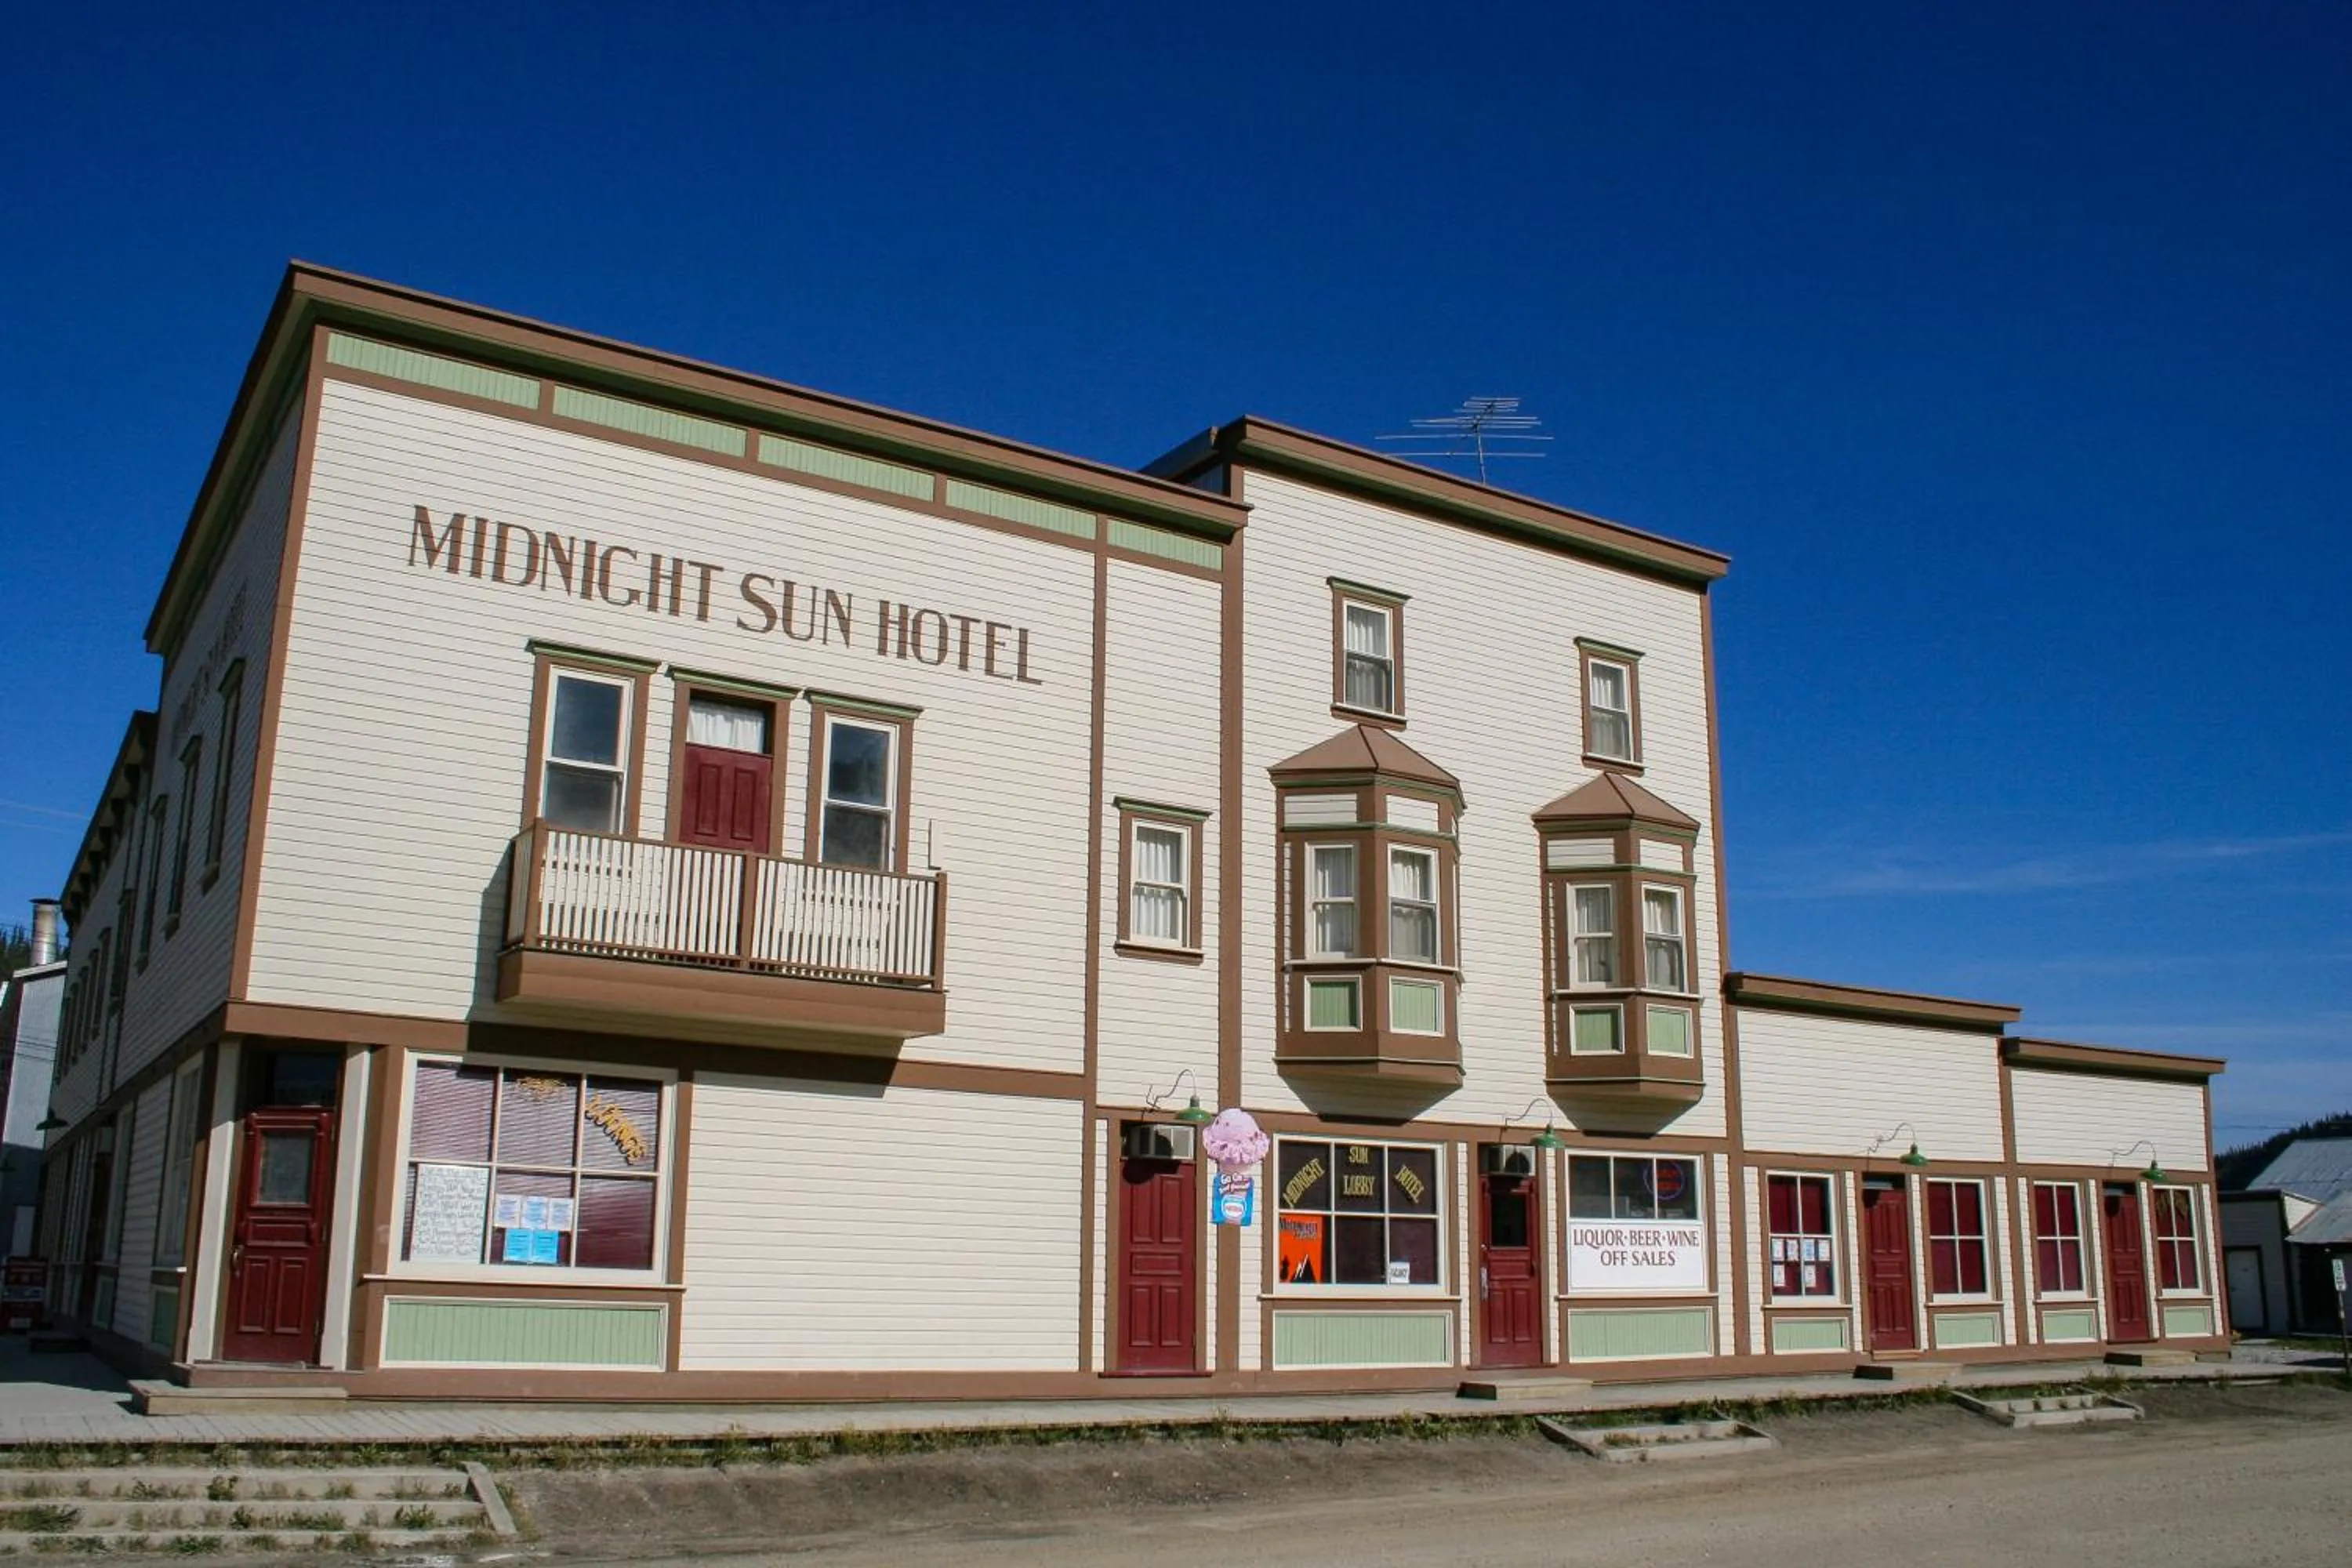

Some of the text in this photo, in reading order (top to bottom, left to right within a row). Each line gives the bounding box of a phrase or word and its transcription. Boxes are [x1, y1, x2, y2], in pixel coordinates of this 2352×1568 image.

[408, 505, 1044, 685] MIDNIGHT SUN HOTEL
[1283, 1146, 1425, 1208] MIDNIGHT SUN HOTEL
[1343, 1175, 1375, 1195] LOBBY
[1573, 1229, 1700, 1249] LIQUOR BEER WINE
[1600, 1250, 1675, 1266] OFF SALES
